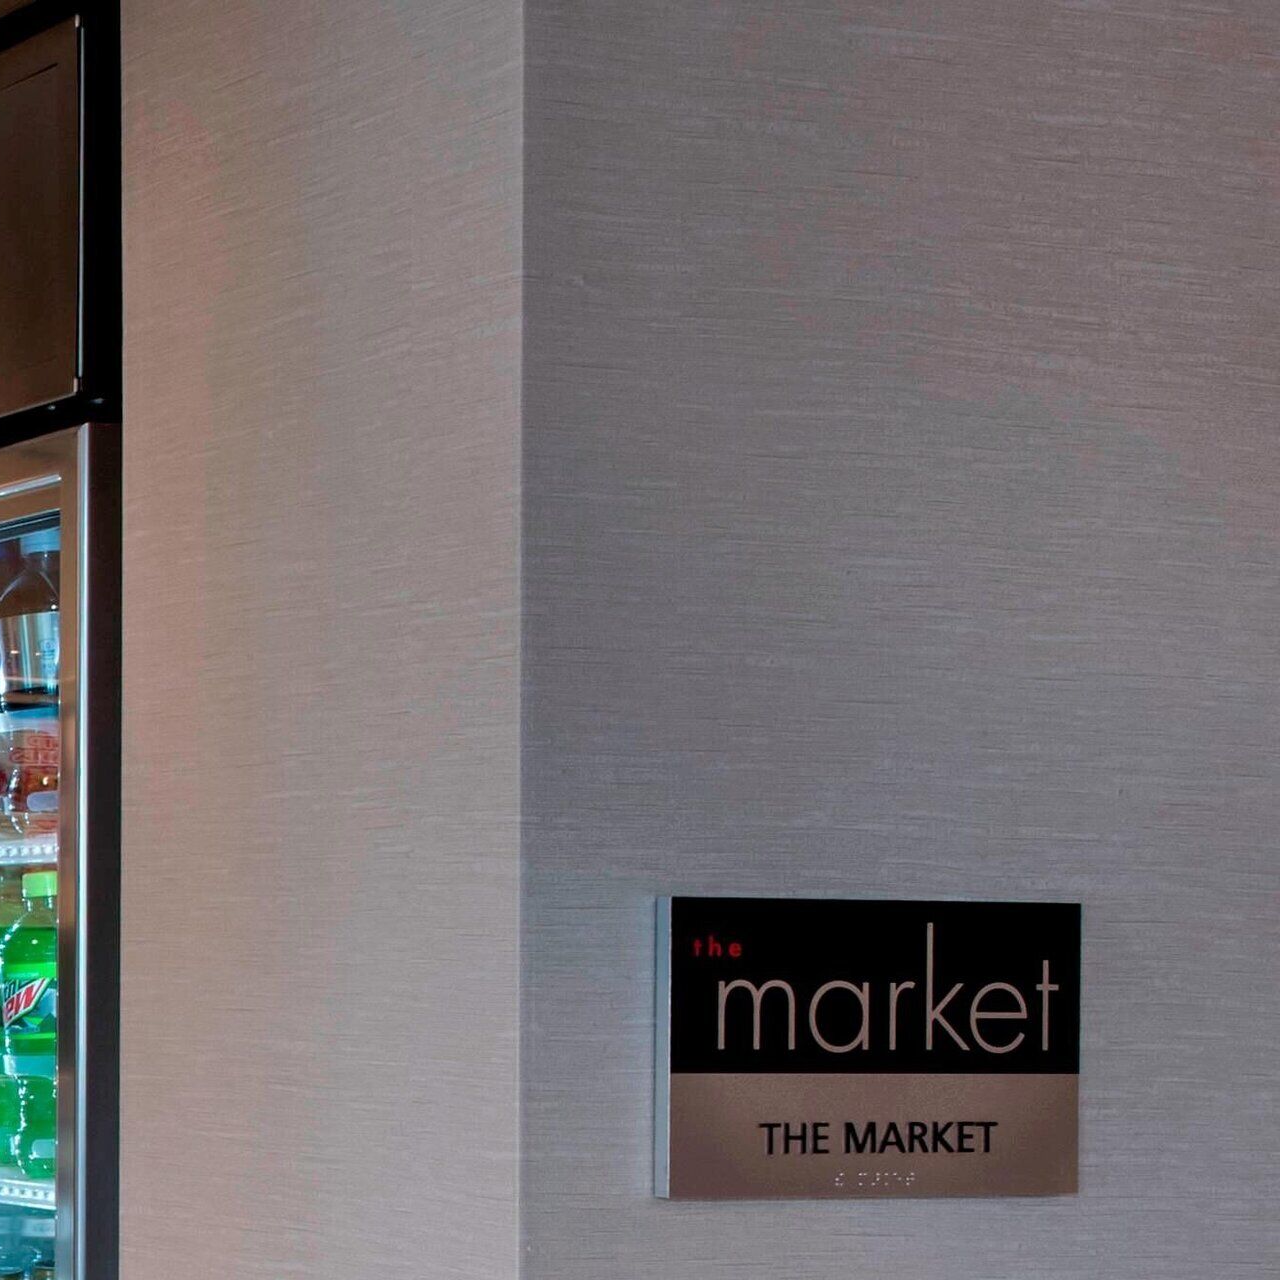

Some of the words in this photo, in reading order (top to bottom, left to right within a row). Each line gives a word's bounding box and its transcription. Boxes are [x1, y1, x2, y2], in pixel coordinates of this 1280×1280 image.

[693, 936, 743, 958] the
[717, 922, 1060, 1054] market
[758, 1122, 830, 1156] THE
[844, 1121, 999, 1155] MARKET
